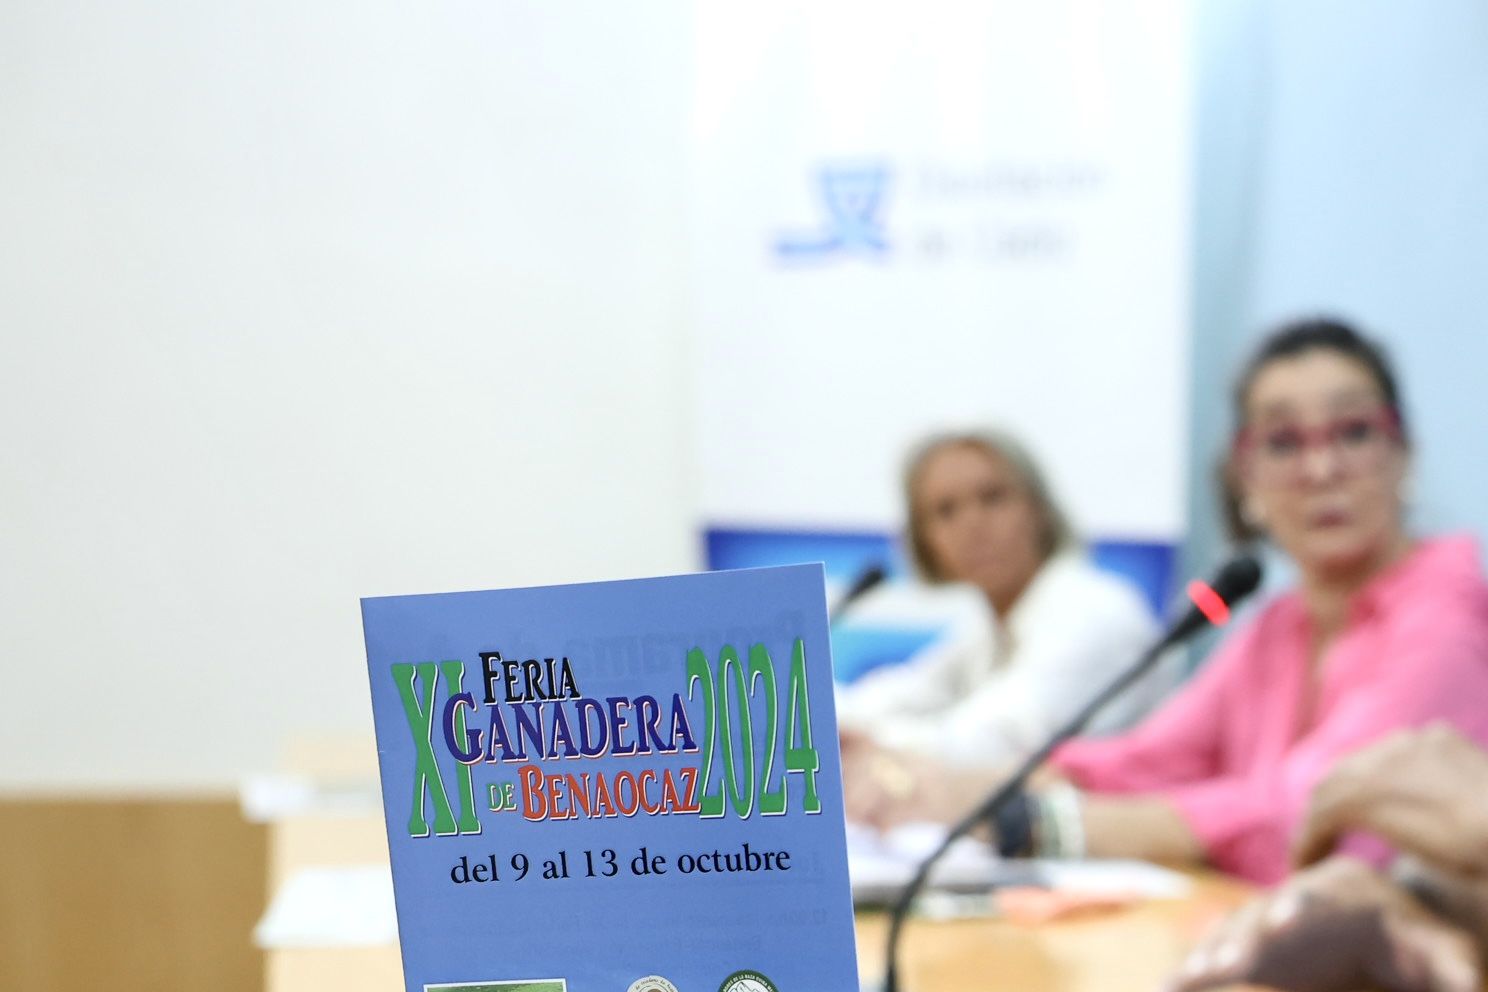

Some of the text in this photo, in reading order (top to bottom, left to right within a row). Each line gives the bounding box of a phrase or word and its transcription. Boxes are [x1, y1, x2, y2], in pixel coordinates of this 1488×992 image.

[479, 650, 582, 705] FERIA
[391, 660, 482, 838] XI
[442, 691, 700, 765] GANADERA
[687, 637, 823, 820] 2024
[487, 765, 702, 822] DE BENAOCAZ
[450, 842, 793, 885] del 9 al 13 de octubre
